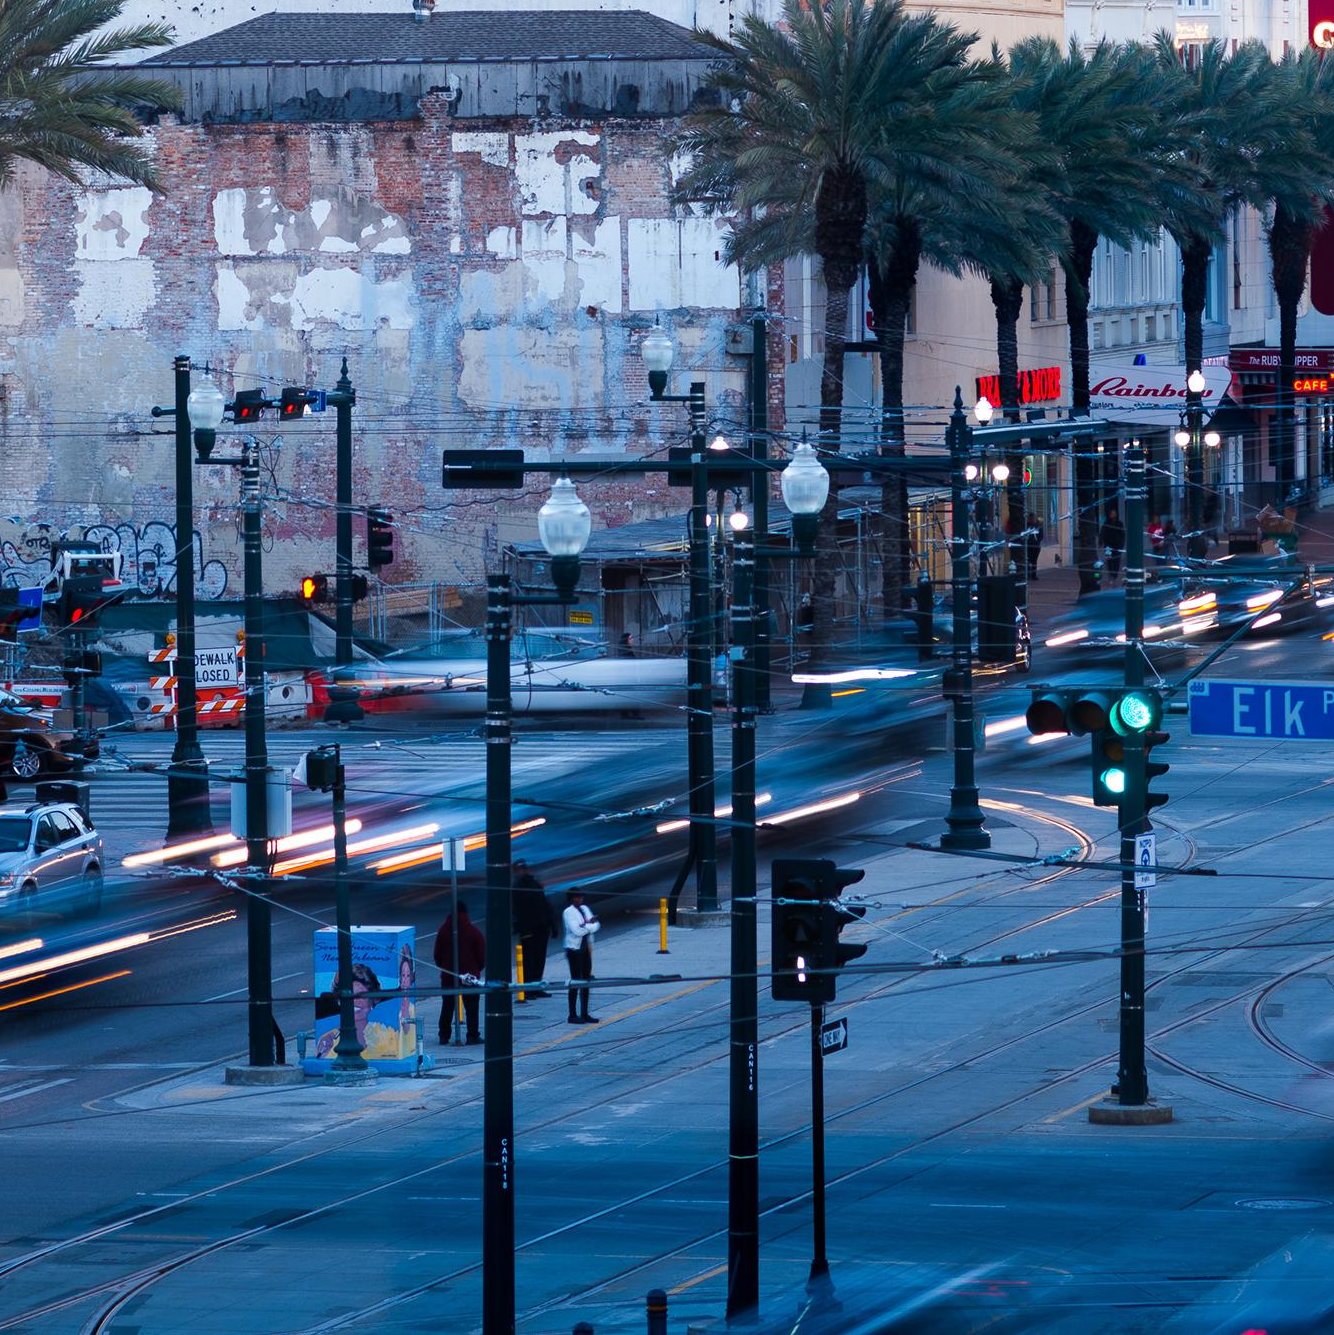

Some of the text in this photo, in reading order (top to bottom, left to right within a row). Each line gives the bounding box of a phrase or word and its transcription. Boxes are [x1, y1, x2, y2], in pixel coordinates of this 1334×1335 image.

[1249, 356, 1260, 365] The
[1031, 367, 1061, 402] MORE
[1294, 380, 1328, 392] CAFE
[195, 652, 234, 667] DEWALK
[196, 669, 230, 683] LOSED
[1233, 687, 1306, 736] Elk
